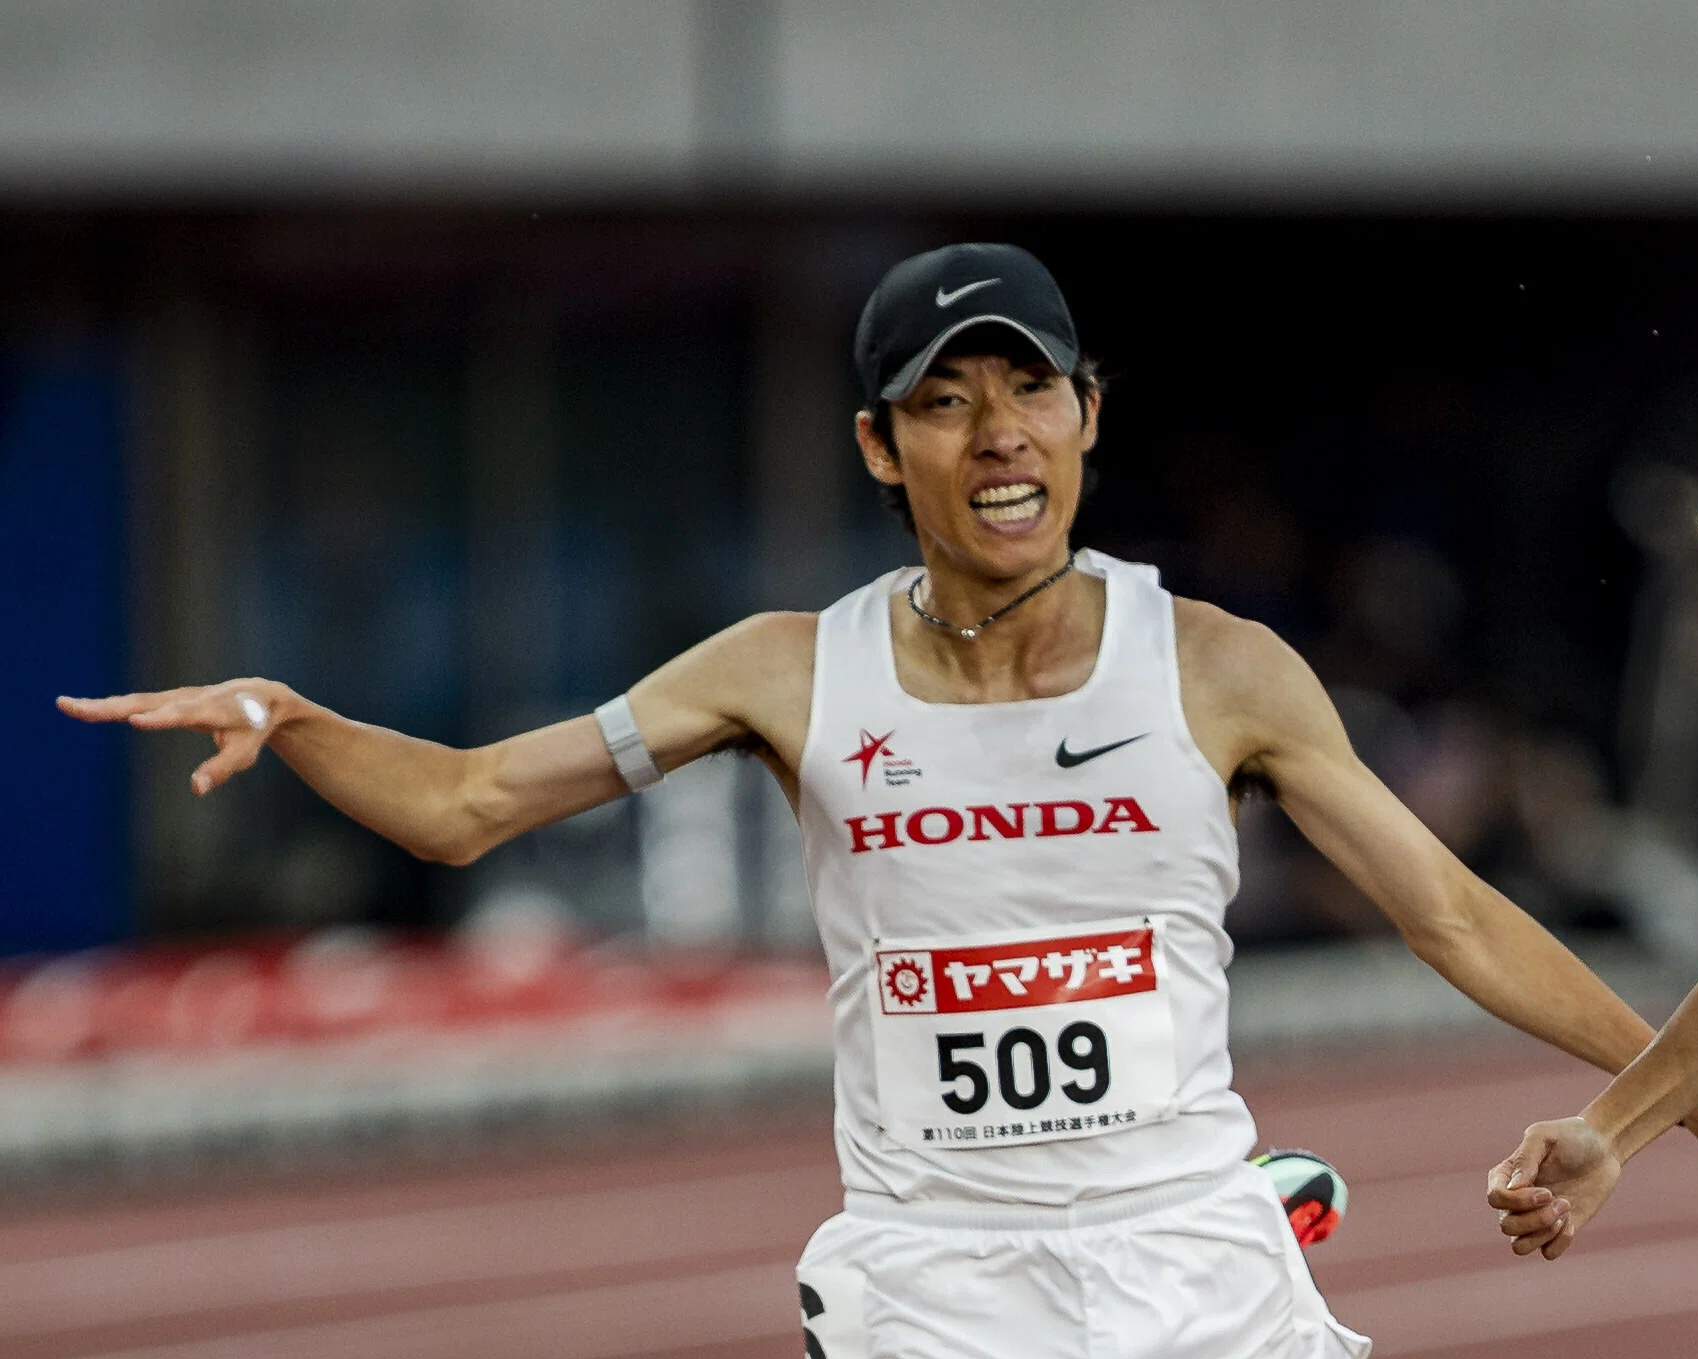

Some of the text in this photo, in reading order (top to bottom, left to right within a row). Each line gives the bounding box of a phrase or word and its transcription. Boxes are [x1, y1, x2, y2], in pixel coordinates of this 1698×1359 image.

[845, 797, 1159, 853] HONDA
[944, 945, 1144, 1002] ヤマザキ
[936, 1020, 1112, 1115] 509
[922, 1108, 1137, 1141] 第110回 日本陸上競技選手権大会
